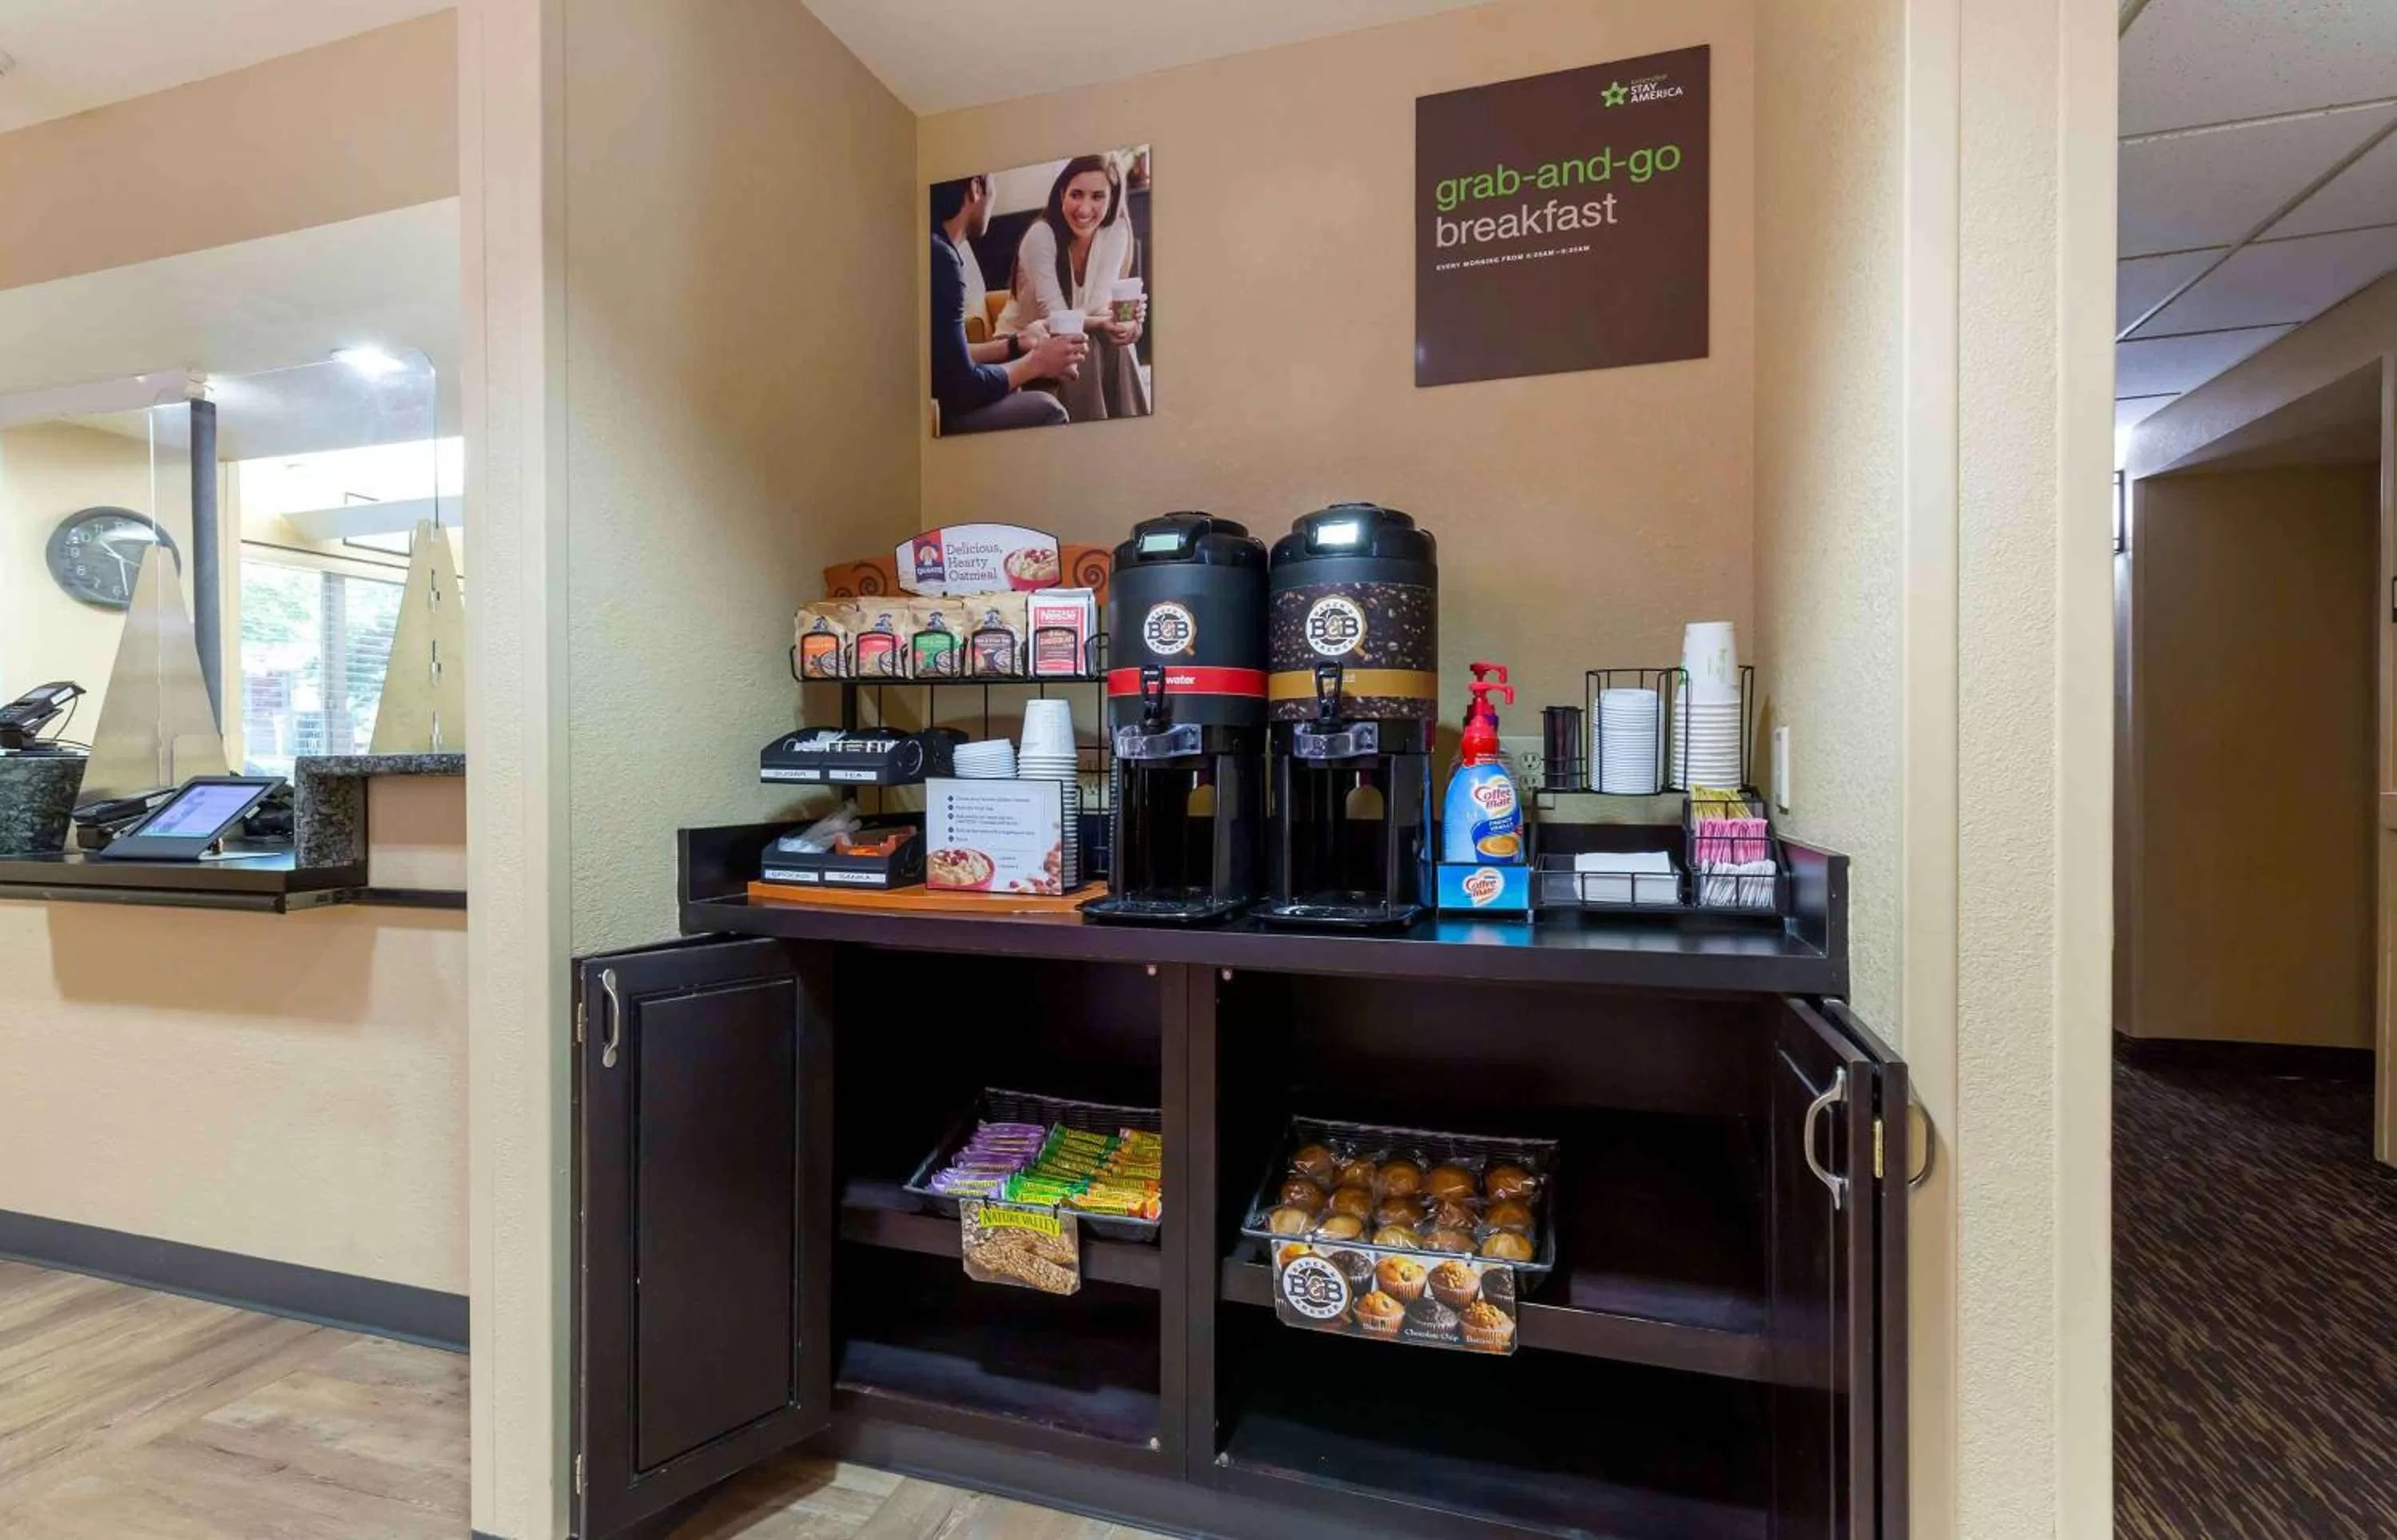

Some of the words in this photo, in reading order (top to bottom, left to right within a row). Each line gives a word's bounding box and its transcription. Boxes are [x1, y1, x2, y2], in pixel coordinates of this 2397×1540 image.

[1631, 82, 1658, 94] STAY
[1631, 86, 1683, 103] AMERICA
[1435, 143, 1682, 212] grab-and-go
[1435, 191, 1618, 248] breakfast
[1436, 262, 1461, 271] EVERY
[1463, 257, 1500, 268] MORNING
[1502, 253, 1524, 262] FROM
[946, 541, 1003, 555] Delicious,
[948, 557, 989, 569] Hearty
[948, 567, 998, 581] Oatmeal
[1147, 621, 1189, 639] B&B
[1310, 615, 1359, 639] B&B
[1165, 675, 1196, 685] water
[1475, 786, 1512, 803] Coffee
[1486, 798, 1511, 809] mate
[1466, 879, 1497, 891] Coffee
[984, 1208, 1020, 1225] NATURE
[1023, 1213, 1059, 1235] VALLEY
[1287, 1273, 1343, 1303] B&B
